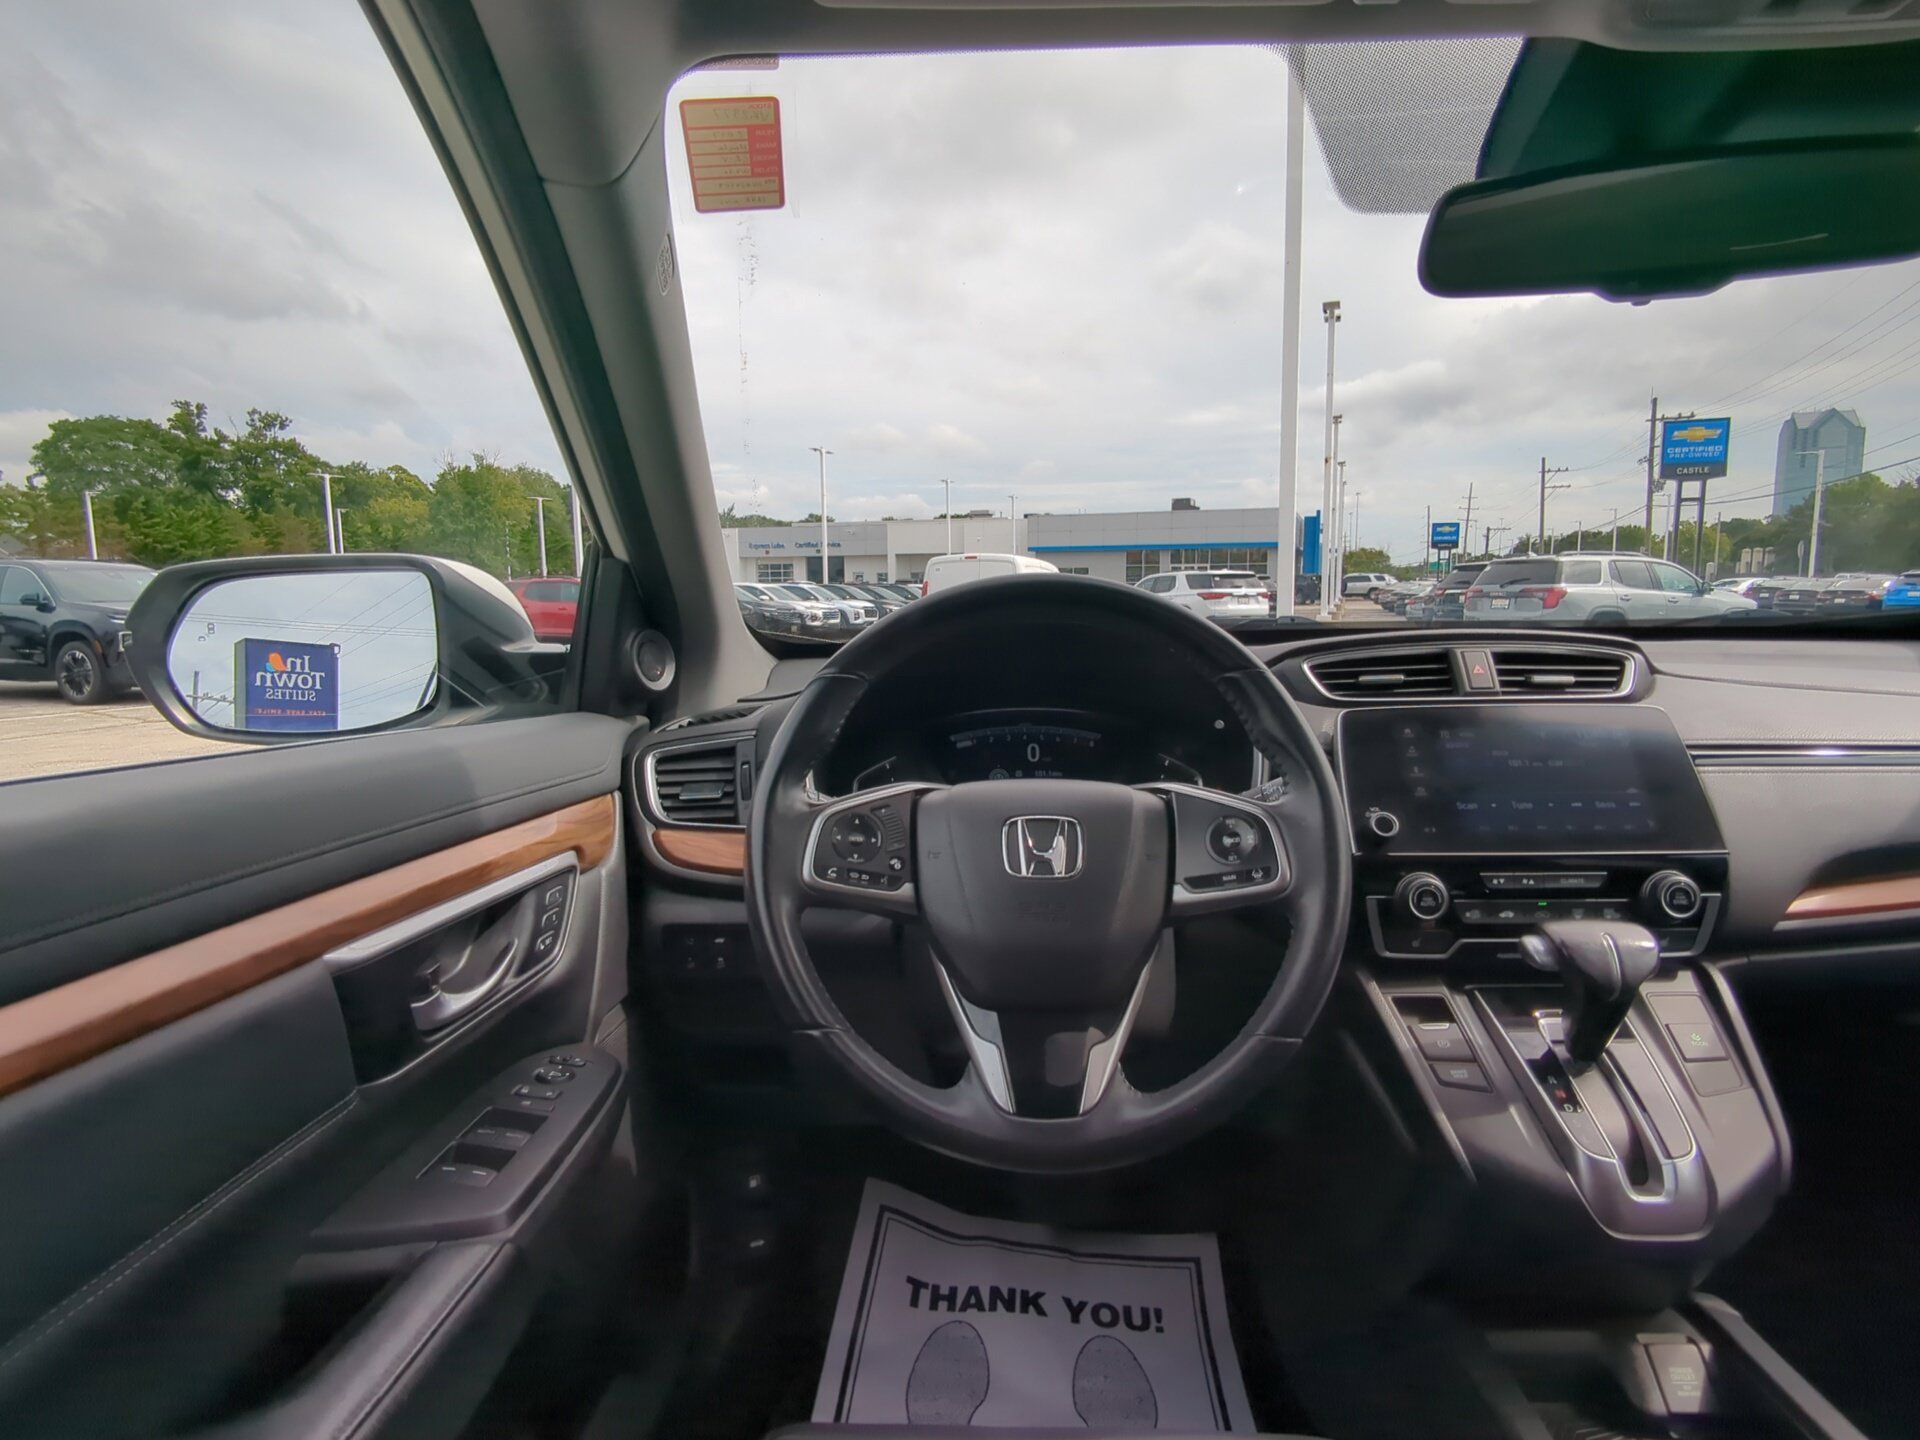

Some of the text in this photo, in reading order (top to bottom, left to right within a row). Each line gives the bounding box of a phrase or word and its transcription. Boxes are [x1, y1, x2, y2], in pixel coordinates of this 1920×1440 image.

[1667, 445, 1723, 453] CERTIFIED
[1676, 466, 1710, 475] CASTLE
[1027, 743, 1040, 762] 0
[905, 1275, 1166, 1334] THANK YOU!
